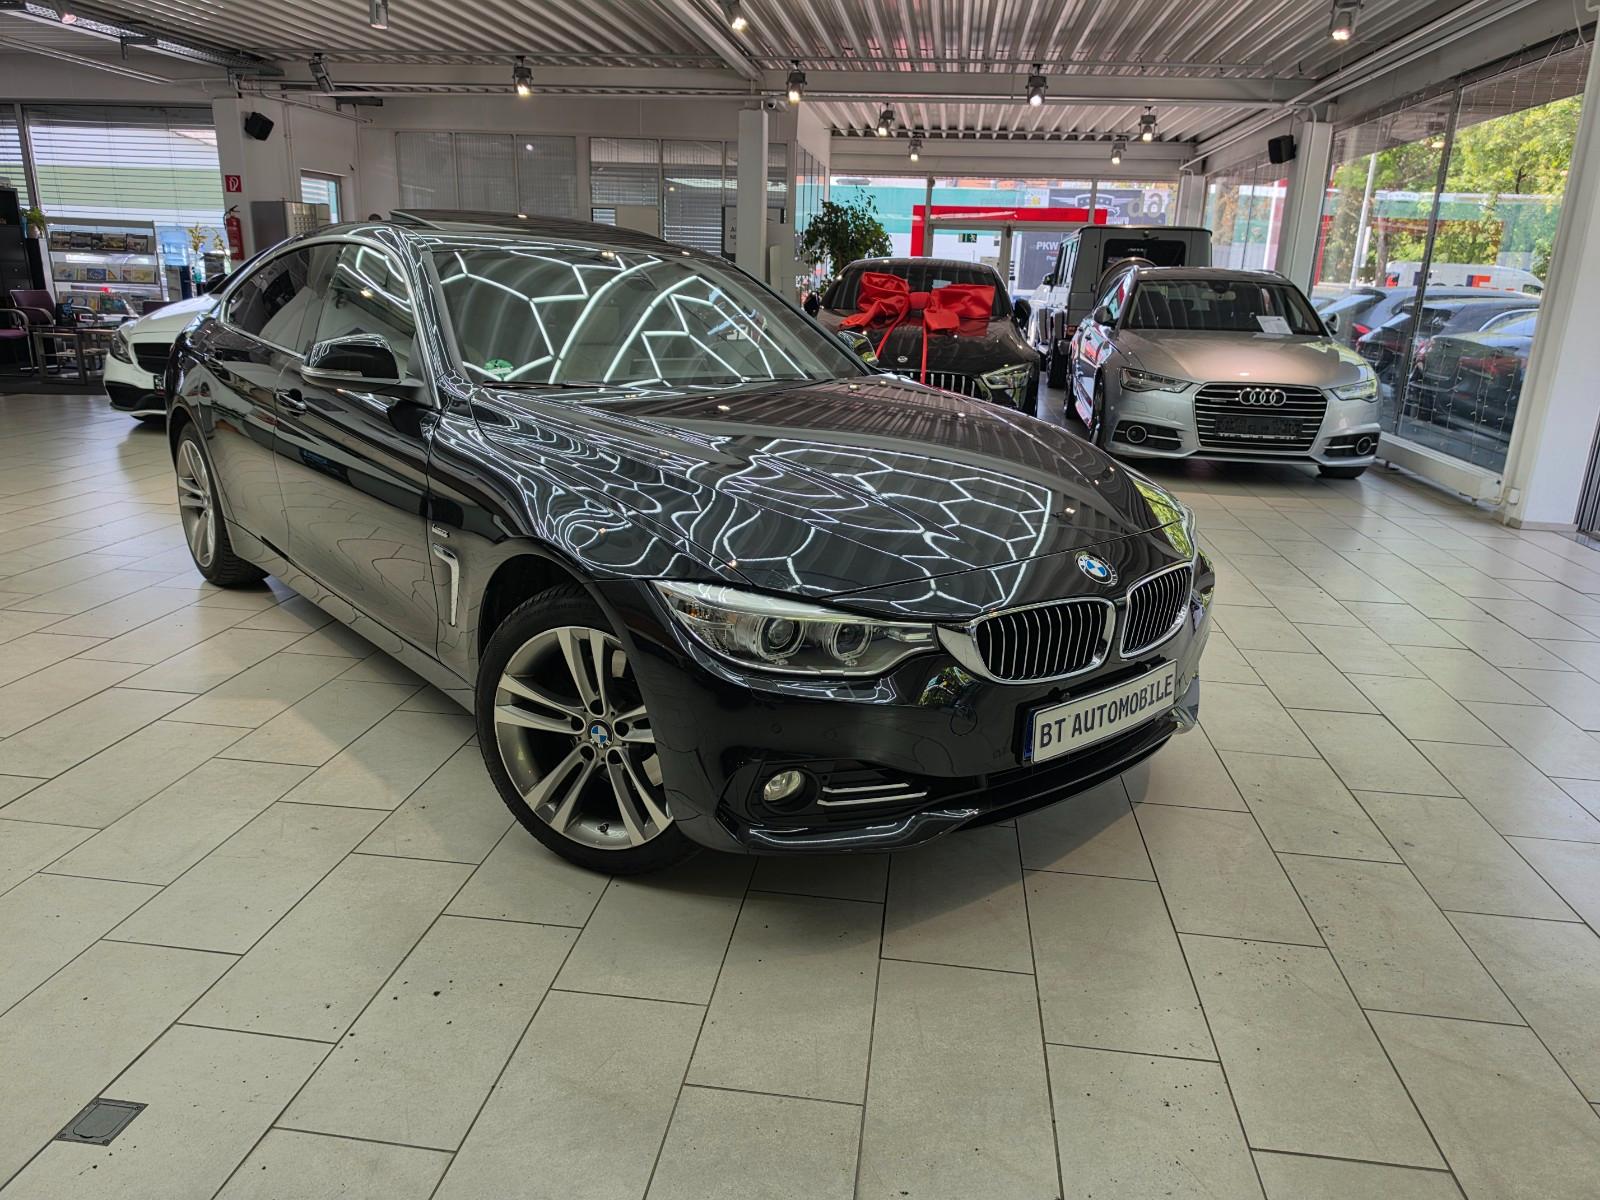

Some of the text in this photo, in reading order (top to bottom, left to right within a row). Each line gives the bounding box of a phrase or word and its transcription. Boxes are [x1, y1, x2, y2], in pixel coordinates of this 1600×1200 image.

[1036, 241, 1059, 250] PKW
[1039, 674, 1174, 749] BT AUTOMOBILE
